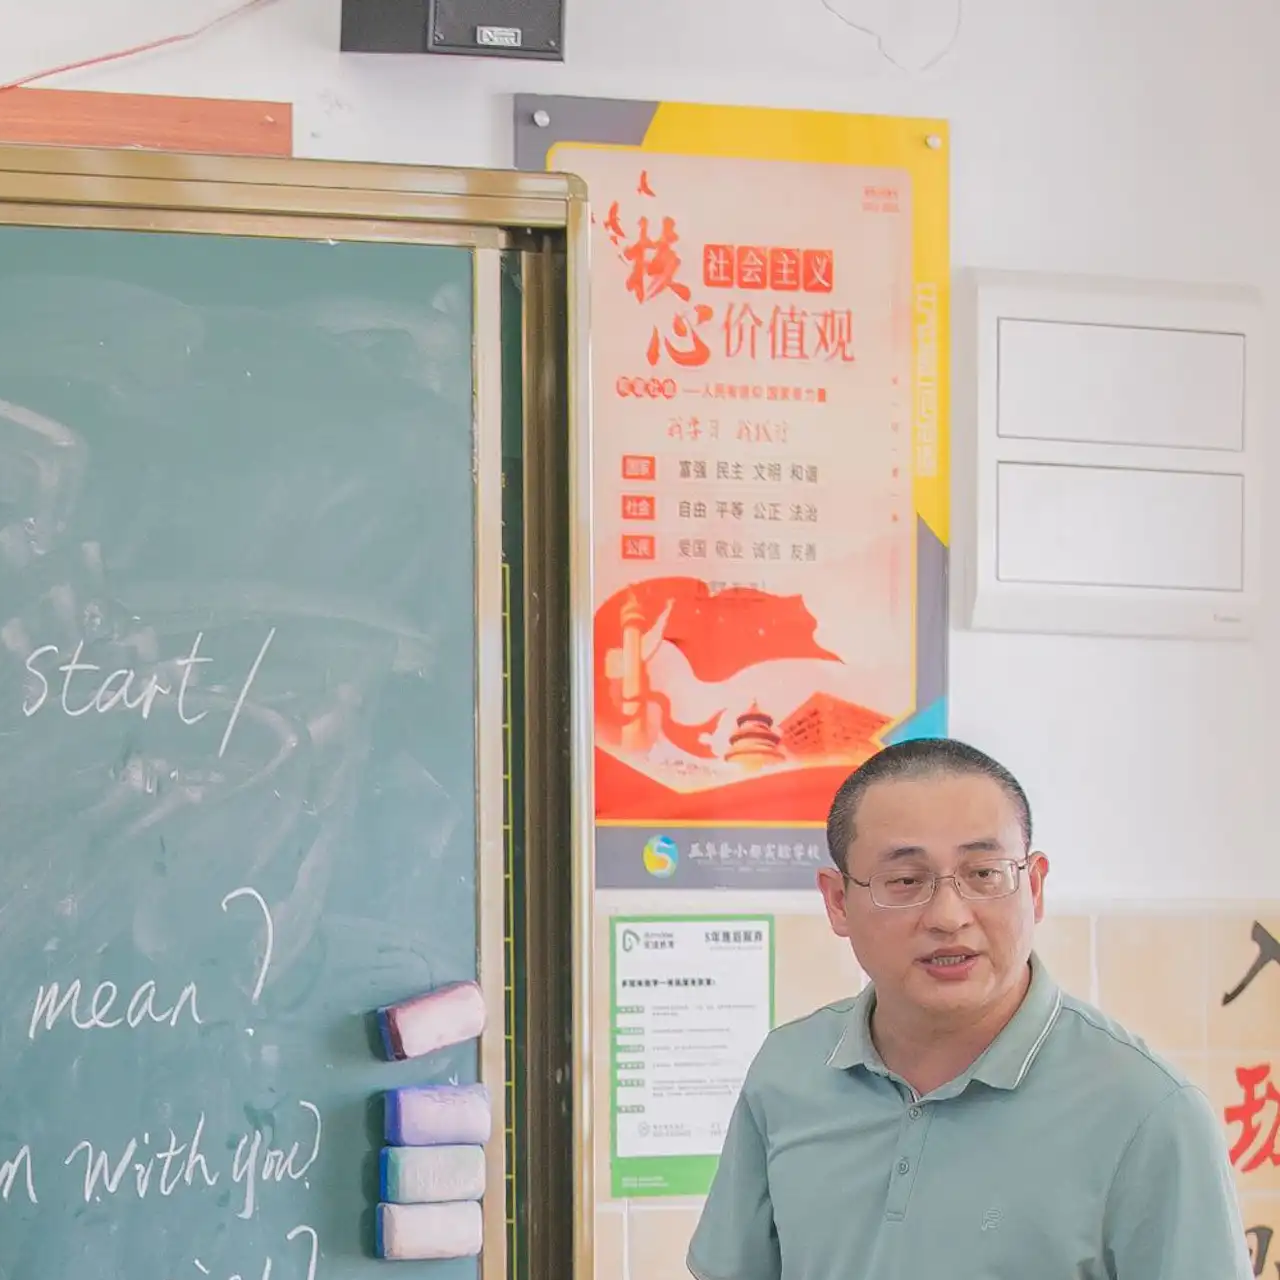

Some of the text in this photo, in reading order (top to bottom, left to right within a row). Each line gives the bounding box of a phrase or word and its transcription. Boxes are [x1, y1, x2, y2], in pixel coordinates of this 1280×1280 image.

[704, 245, 834, 293] 社会主义
[721, 302, 856, 363] 价值观
[717, 461, 744, 480] 民主
[752, 463, 783, 482] 文明
[679, 501, 708, 519] 自由
[716, 501, 745, 520] 平等
[753, 503, 783, 521] 公正
